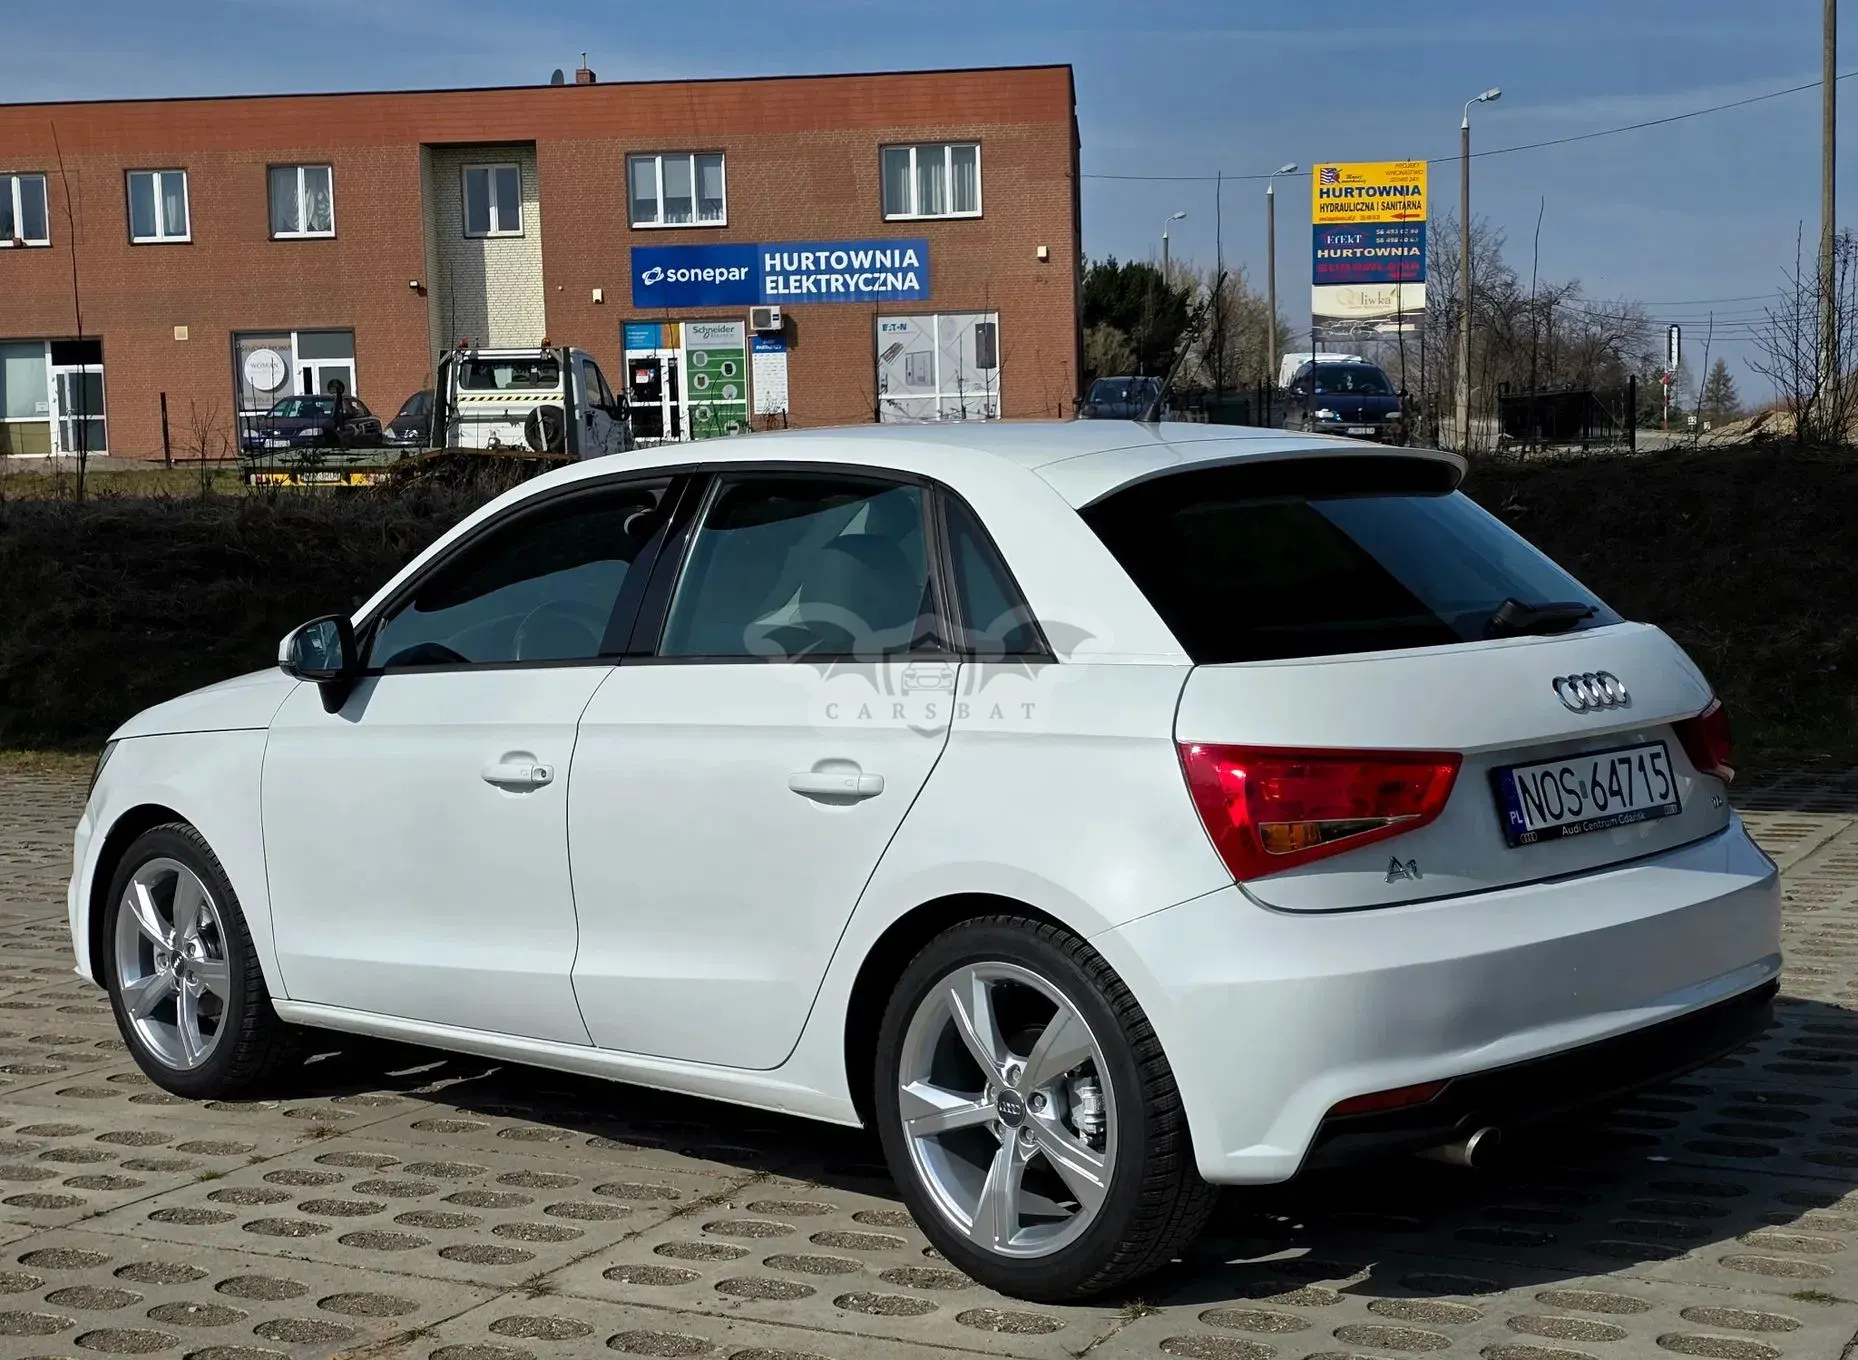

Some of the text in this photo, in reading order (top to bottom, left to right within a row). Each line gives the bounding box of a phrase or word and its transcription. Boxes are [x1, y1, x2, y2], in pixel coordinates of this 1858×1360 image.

[1319, 185, 1422, 199] HURTOWNIA
[1319, 202, 1375, 213] HYDRAULICZNA
[1381, 200, 1422, 211] SANITARNA
[764, 249, 920, 272] HURTOWNIA
[1317, 247, 1421, 258] HURTOWNIA
[666, 267, 749, 285] sonepar
[765, 272, 921, 295] ELEKTRYCZNA
[693, 325, 735, 339] Schneider
[1518, 752, 1670, 826] NOS 64715
[1509, 811, 1524, 825] PL
[1562, 825, 1582, 836] Audi
[1583, 817, 1617, 832] Centrum
